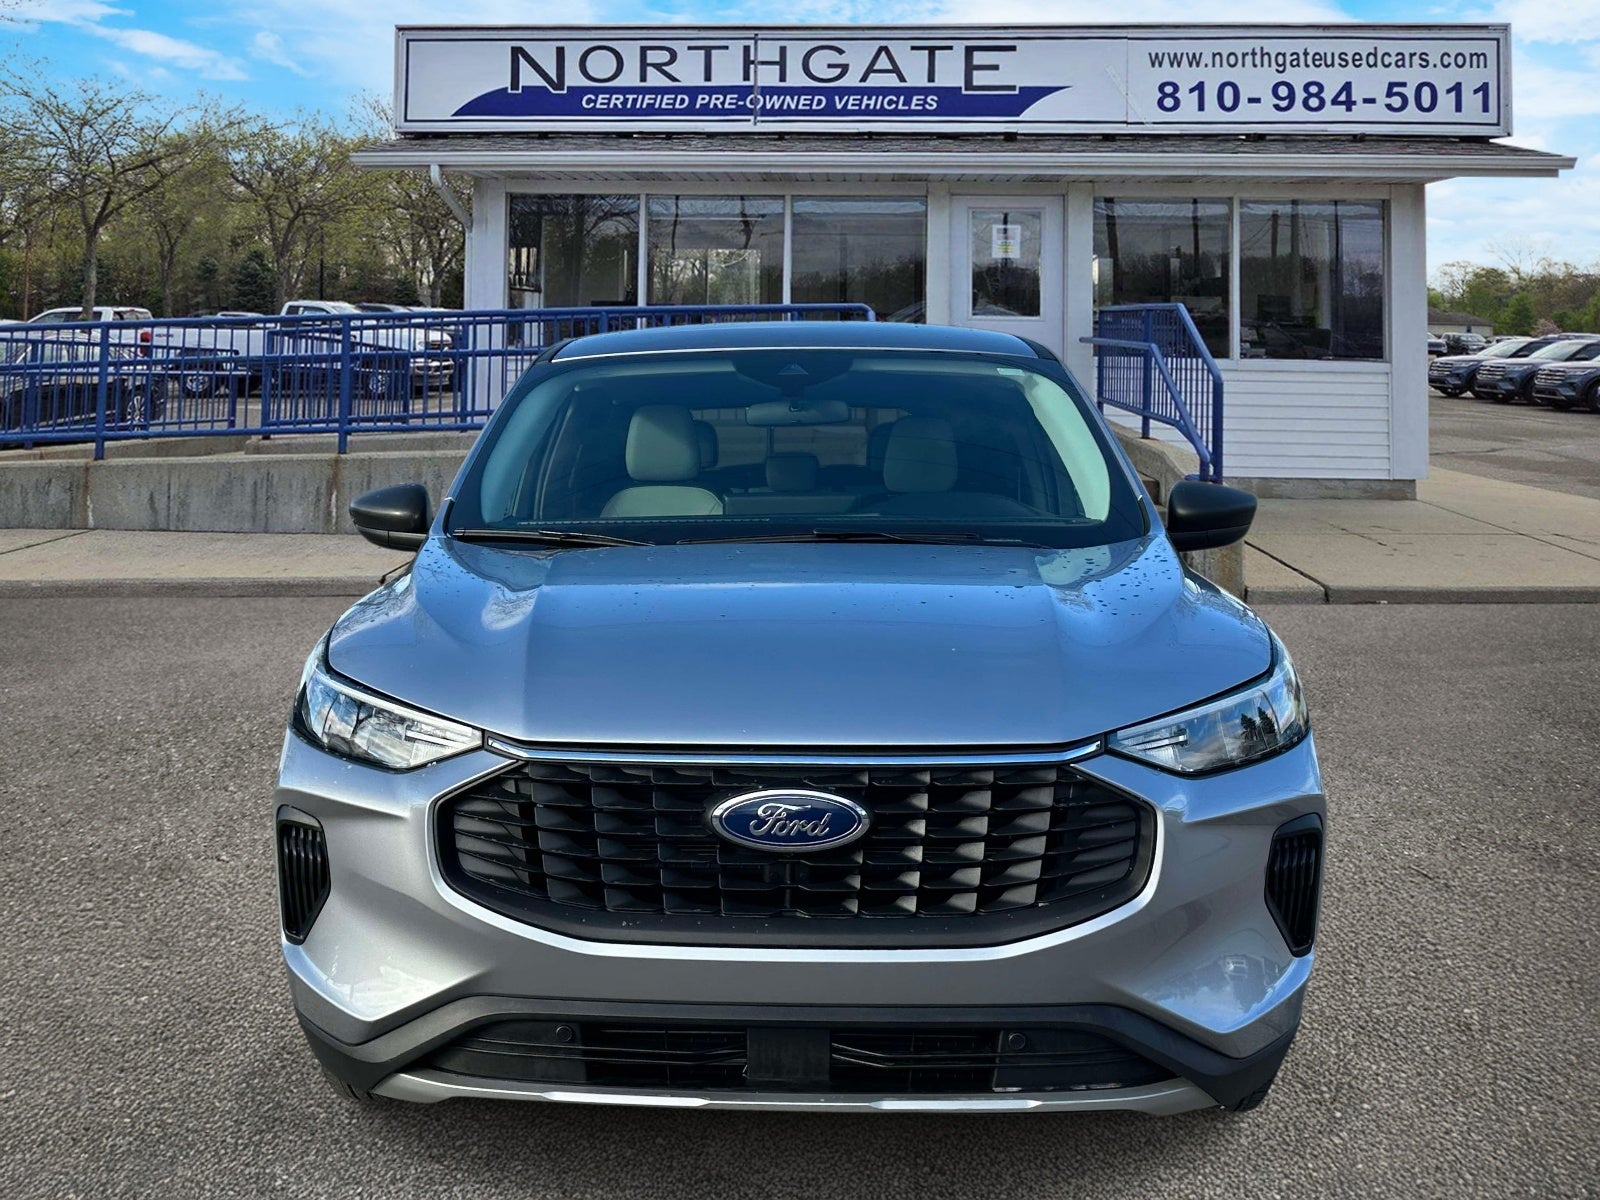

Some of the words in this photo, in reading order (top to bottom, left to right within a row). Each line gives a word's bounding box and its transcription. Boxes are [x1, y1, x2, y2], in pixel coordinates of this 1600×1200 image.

[509, 44, 1018, 93] NORTHGATE
[1148, 46, 1489, 74] www.northgateusedcars.com
[581, 93, 690, 110] CERTIFIED
[695, 93, 827, 111] PRE-OWNED
[834, 94, 939, 111] VEHICLES
[1156, 80, 1492, 114] 810-984-5011
[750, 802, 832, 836] Ford
